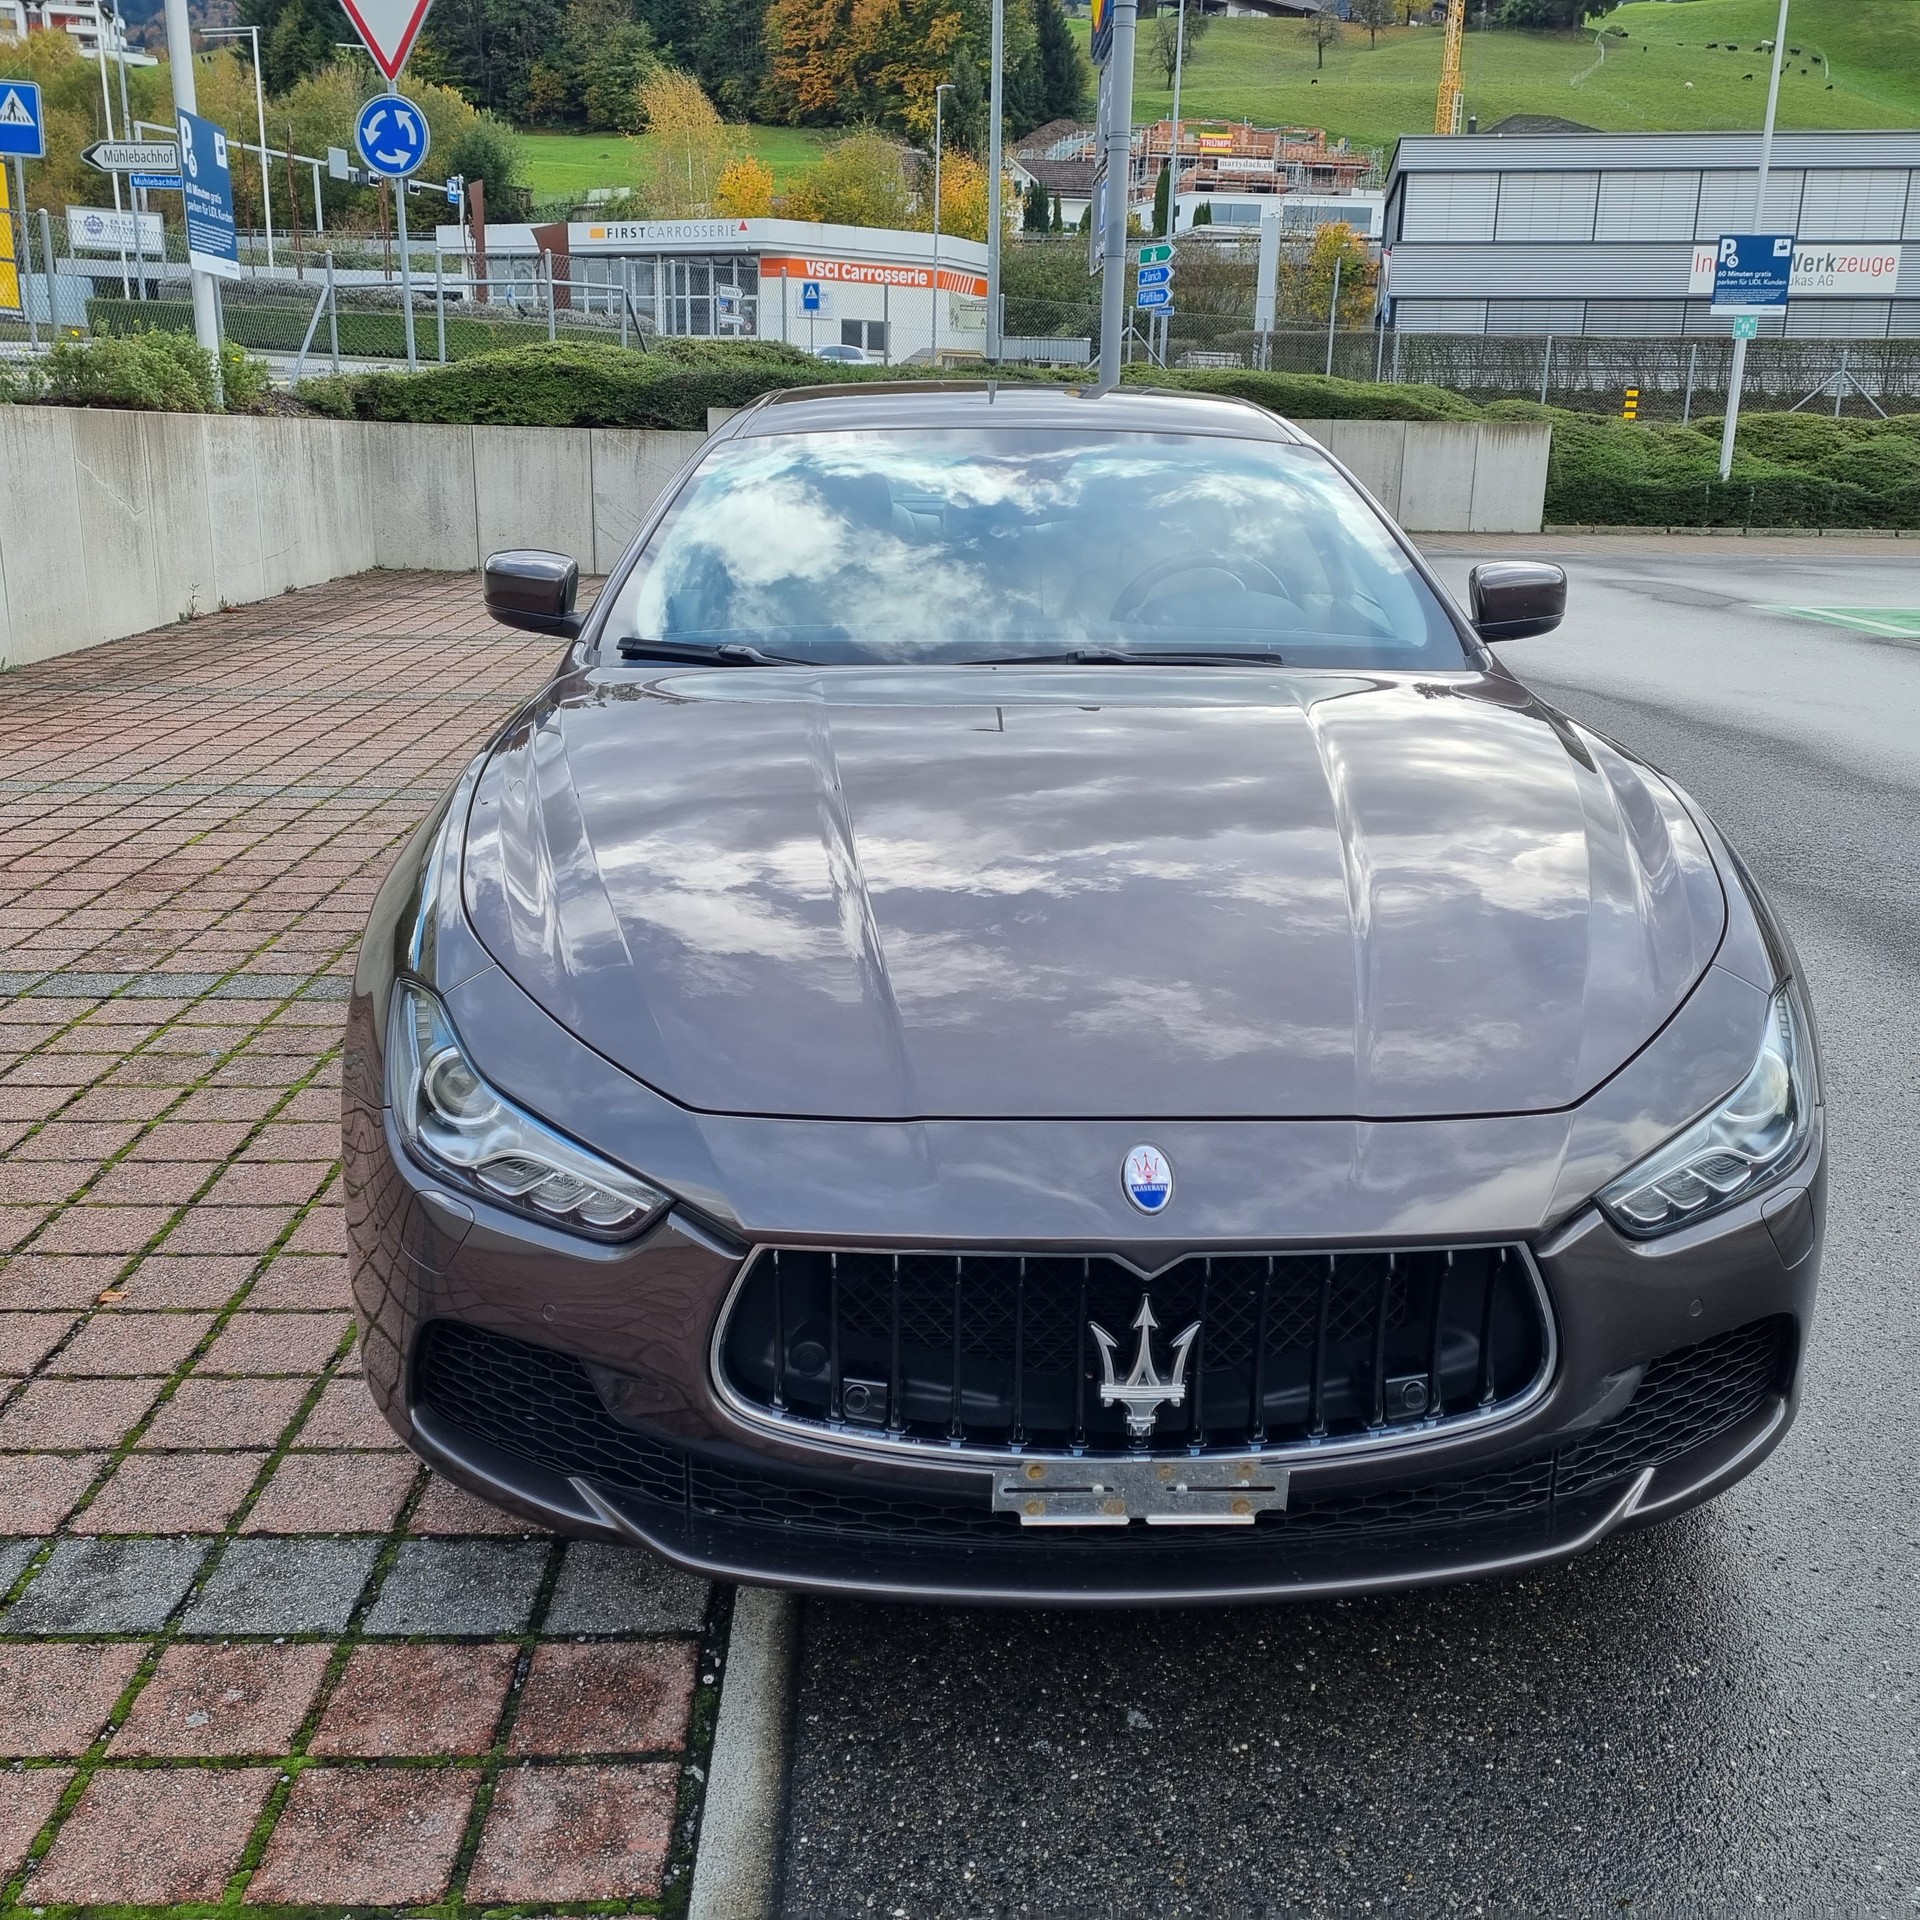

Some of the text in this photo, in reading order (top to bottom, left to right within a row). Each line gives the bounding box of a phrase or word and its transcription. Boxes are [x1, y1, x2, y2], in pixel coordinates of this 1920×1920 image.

[179, 115, 193, 164] P
[1201, 138, 1232, 148] TRÜMPI
[104, 149, 173, 163] Mühlebachhof
[1219, 160, 1273, 169] martydach.ch
[1719, 238, 1737, 263] P
[805, 260, 928, 285] VSCI Carrosserie
[1142, 270, 1162, 283] Zürich
[1817, 275, 1834, 286] AG
[1140, 291, 1164, 304] Pfäffikon
[1132, 1184, 1168, 1192] MASERATI
